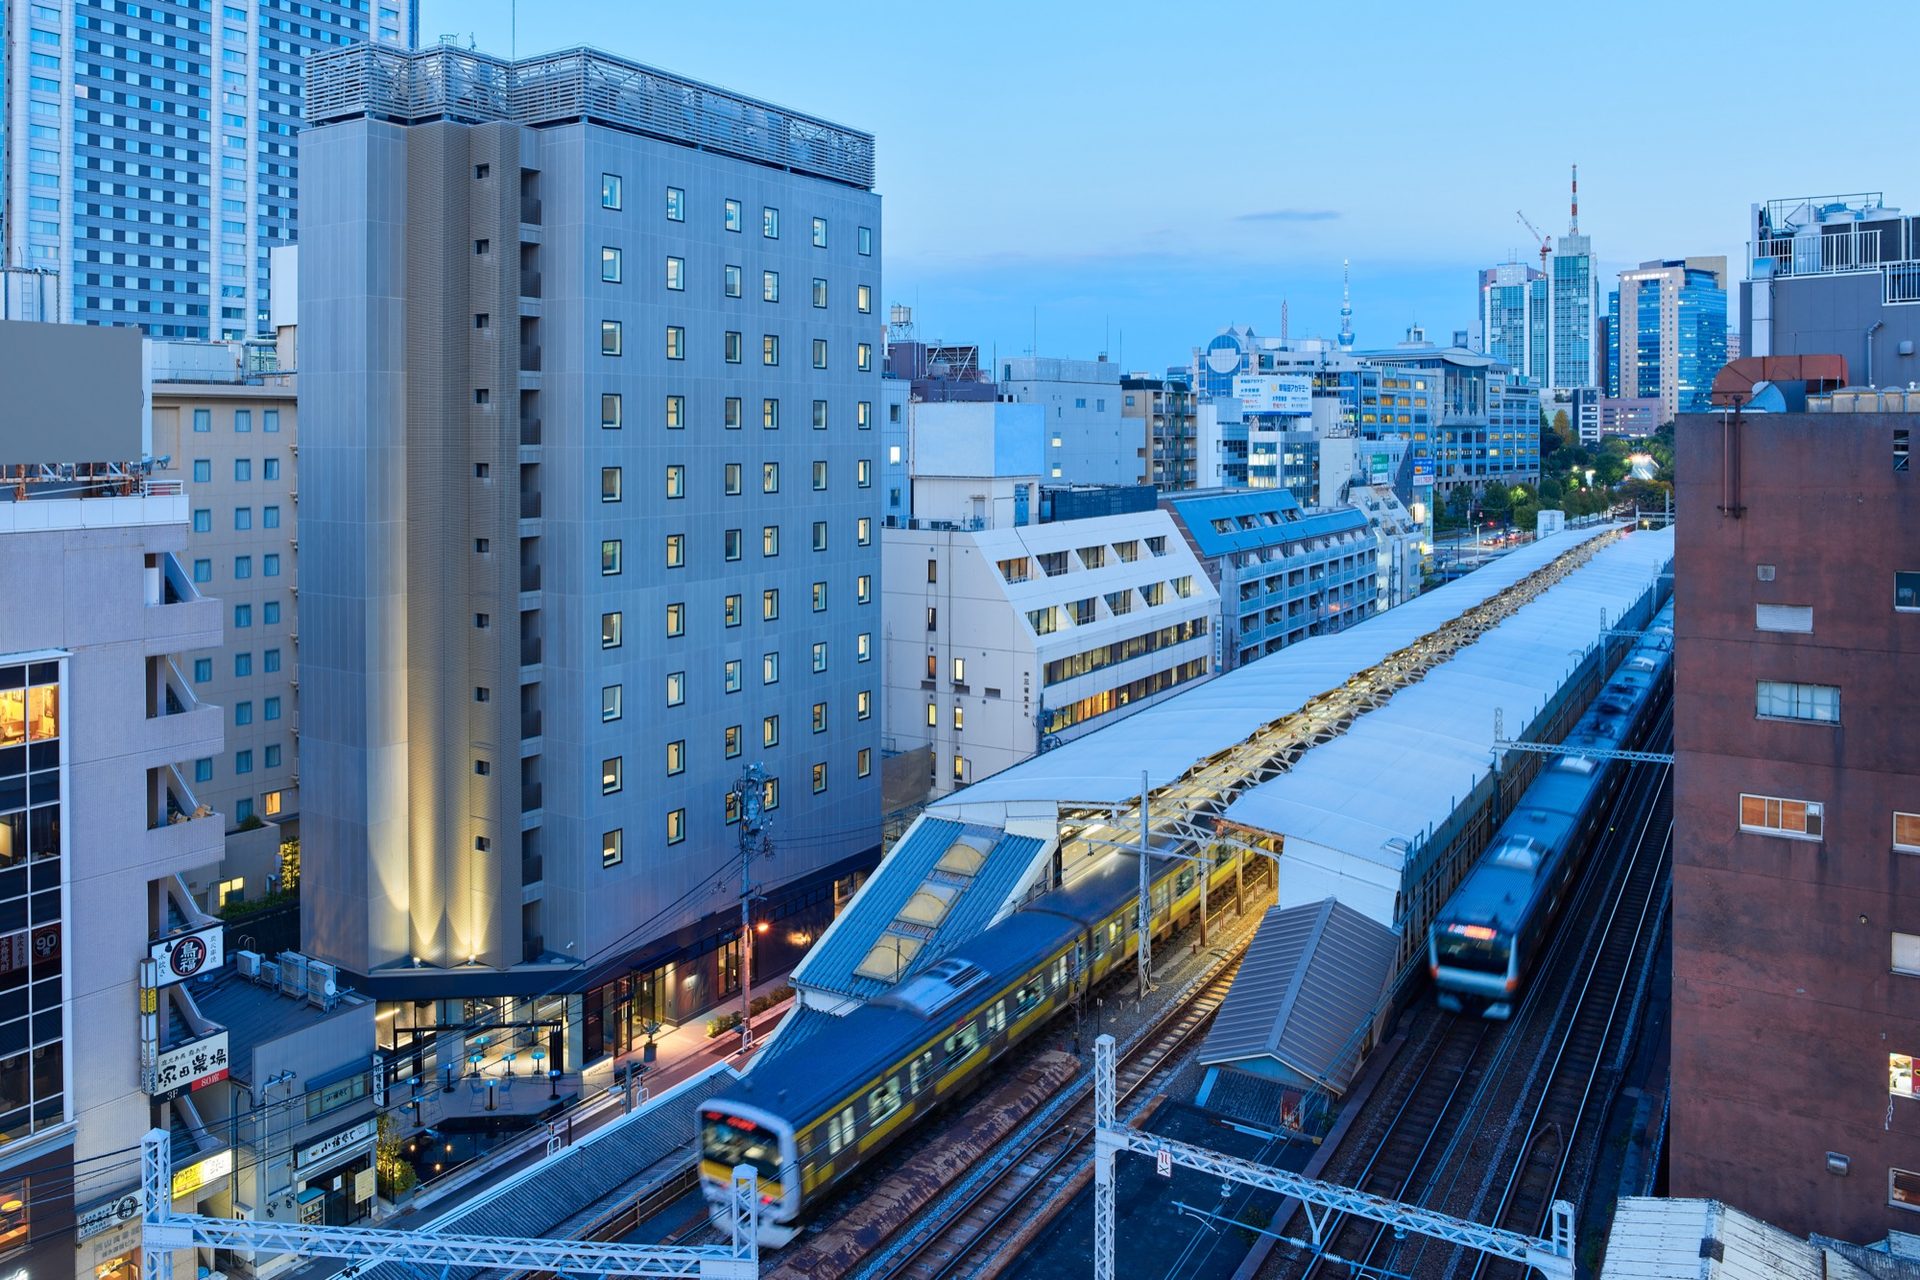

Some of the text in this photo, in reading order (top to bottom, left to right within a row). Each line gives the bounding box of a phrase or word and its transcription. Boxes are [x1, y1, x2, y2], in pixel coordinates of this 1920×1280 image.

[36, 934, 57, 950] 90
[180, 941, 198, 973] 鳥福
[166, 1088, 178, 1101] 3F
